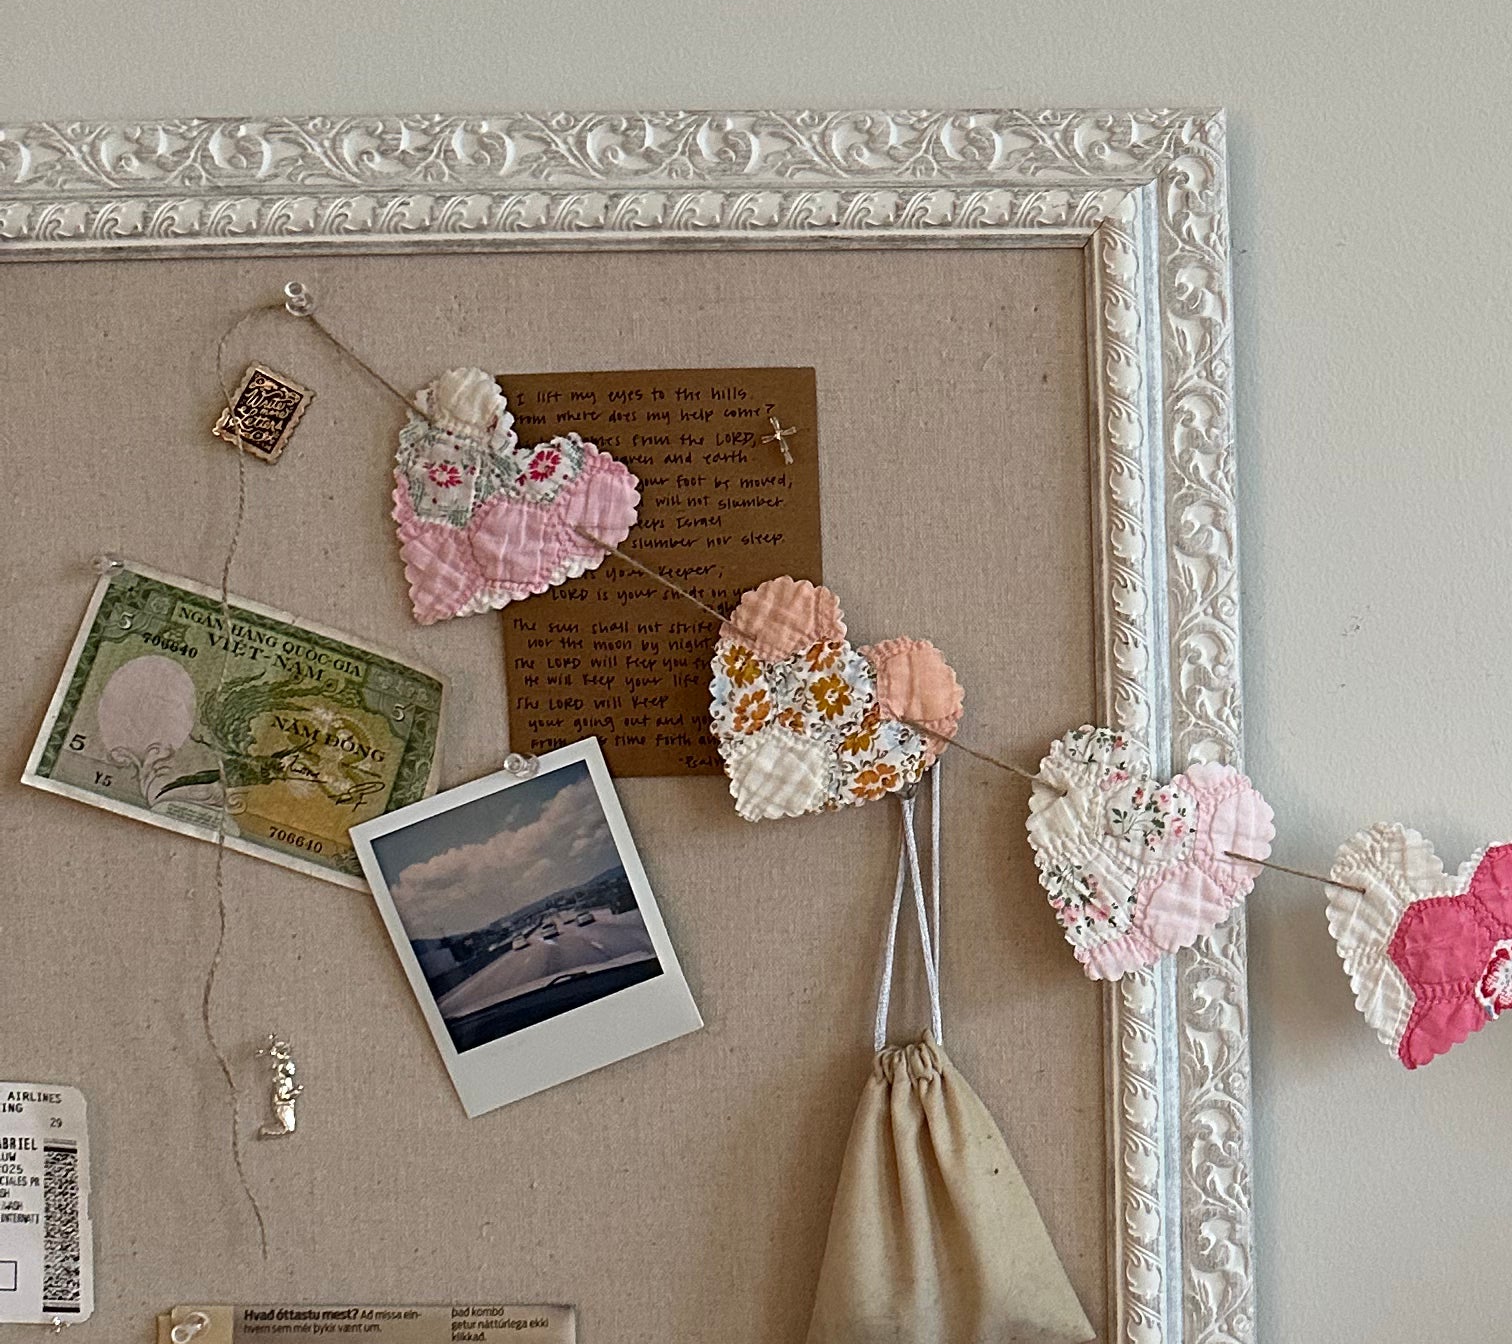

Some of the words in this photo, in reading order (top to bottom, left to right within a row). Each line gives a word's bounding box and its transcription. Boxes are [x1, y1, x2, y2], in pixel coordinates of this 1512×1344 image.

[517, 392, 525, 406] I
[571, 392, 596, 404] my
[608, 390, 643, 403] eyes
[651, 389, 665, 401] to
[675, 388, 700, 401] the
[514, 414, 546, 425] rom
[609, 410, 636, 423] does
[647, 411, 670, 424] my
[680, 409, 713, 423] help
[680, 433, 704, 446] the
[716, 431, 756, 448] LORD,
[664, 453, 692, 464] and
[703, 450, 747, 463] earth
[655, 496, 680, 506] will
[687, 496, 709, 506] not
[635, 517, 665, 532] eeps
[676, 515, 722, 529] Israel
[632, 536, 697, 549] slumber
[707, 537, 732, 548] nor
[552, 588, 588, 602] LORD
[597, 589, 608, 601] is
[617, 589, 657, 606] your
[712, 588, 726, 598] on
[118, 612, 134, 630] 5
[513, 618, 536, 631] The
[549, 624, 579, 633] sun
[592, 622, 629, 634] shall
[638, 623, 663, 634] not
[528, 638, 553, 649] nor
[560, 637, 583, 649] the
[593, 639, 632, 651] moon
[642, 638, 659, 654] by
[591, 657, 617, 668] will
[663, 658, 687, 671] you
[524, 675, 539, 686] He
[547, 674, 572, 686] will
[624, 676, 662, 693] your
[392, 703, 407, 721] 5
[550, 698, 584, 710] LORD
[594, 697, 622, 708] will
[528, 719, 564, 733] your
[574, 716, 614, 732] going
[624, 717, 650, 727] out
[656, 715, 684, 726] and
[69, 734, 86, 751] 5
[8, 1092, 62, 1104] AIRLINES
[244, 1309, 275, 1321] Hvað
[322, 1308, 359, 1320] mest?
